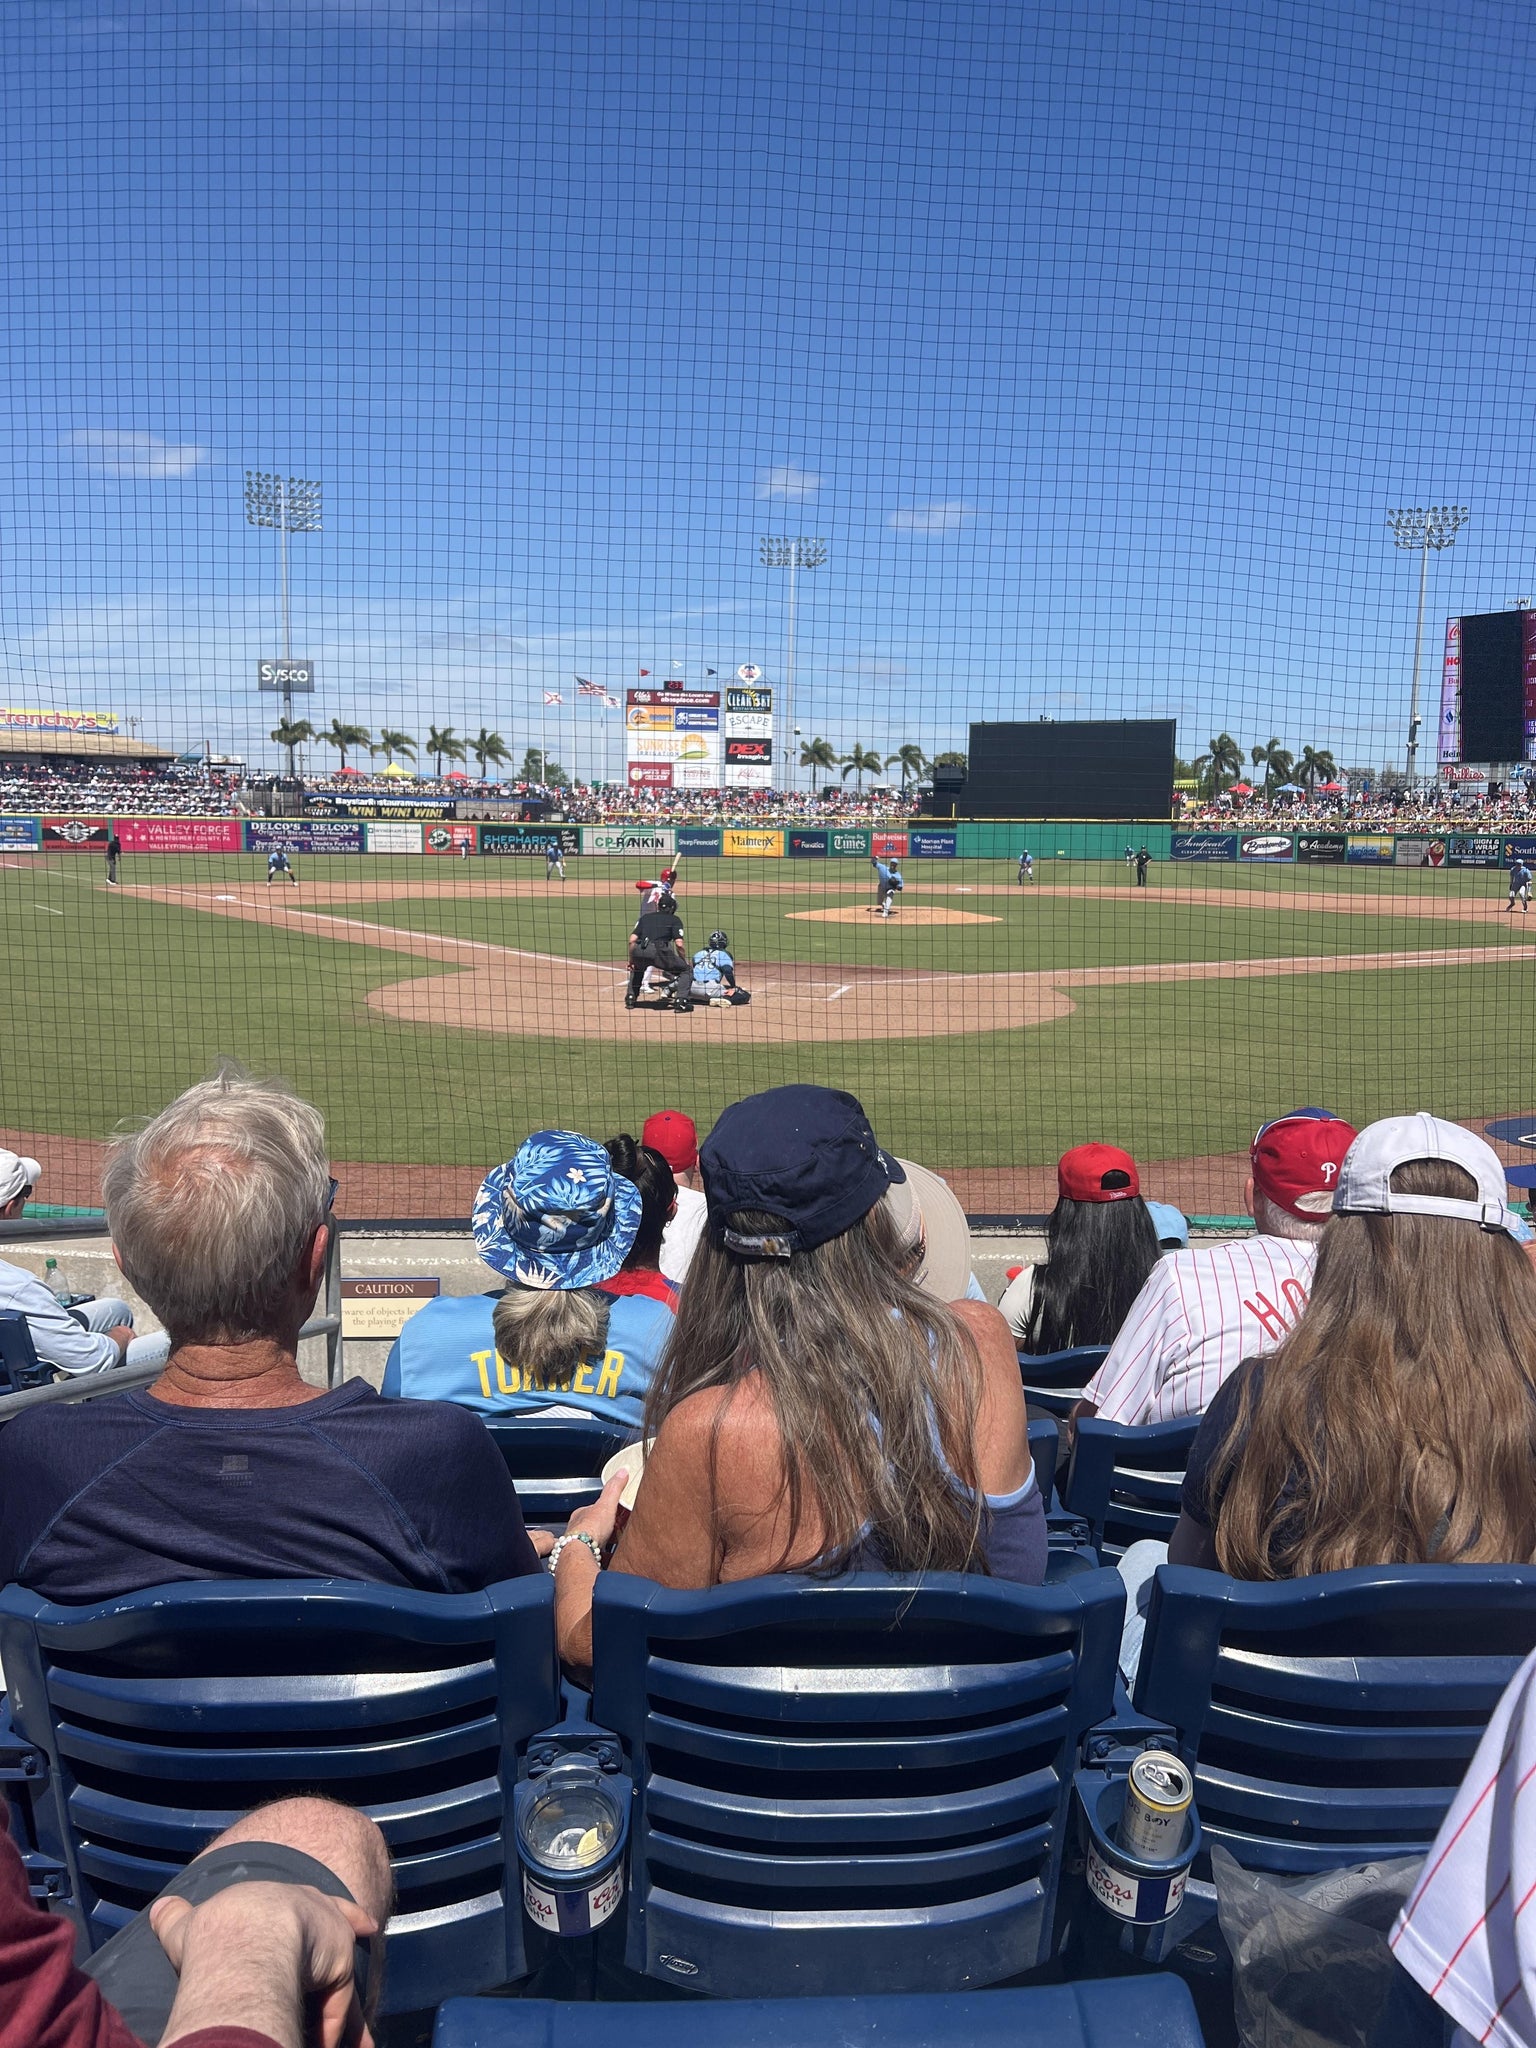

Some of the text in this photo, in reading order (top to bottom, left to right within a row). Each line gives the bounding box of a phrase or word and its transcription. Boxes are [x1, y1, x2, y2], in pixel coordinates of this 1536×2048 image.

[261, 664, 308, 684] Sysco
[729, 715, 769, 727] ESCAPE
[638, 739, 679, 751] SUNRISE
[728, 743, 765, 755] DEX
[1443, 766, 1485, 781] Phillies
[381, 807, 411, 816] WIN!
[414, 808, 443, 817] WIN!
[147, 825, 230, 835] VALLEY FORGE
[251, 822, 300, 831] DELCO'S
[311, 823, 359, 831] DELCO'S
[484, 835, 558, 844] SHEPHARD'S
[595, 837, 664, 847] CP-RANKIN
[834, 835, 866, 850] Times
[872, 832, 907, 841] Budweiser
[1309, 840, 1344, 852] Academy
[1320, 1162, 1337, 1183] P
[355, 1283, 414, 1294] CAUTION
[366, 1307, 375, 1316] of
[377, 1307, 405, 1318] objects
[353, 1317, 366, 1326] the
[368, 1318, 397, 1328] playing
[470, 1348, 625, 1398] TUER
[1089, 1855, 1133, 1900] Coors
[1091, 1876, 1122, 1905] LIGHT
